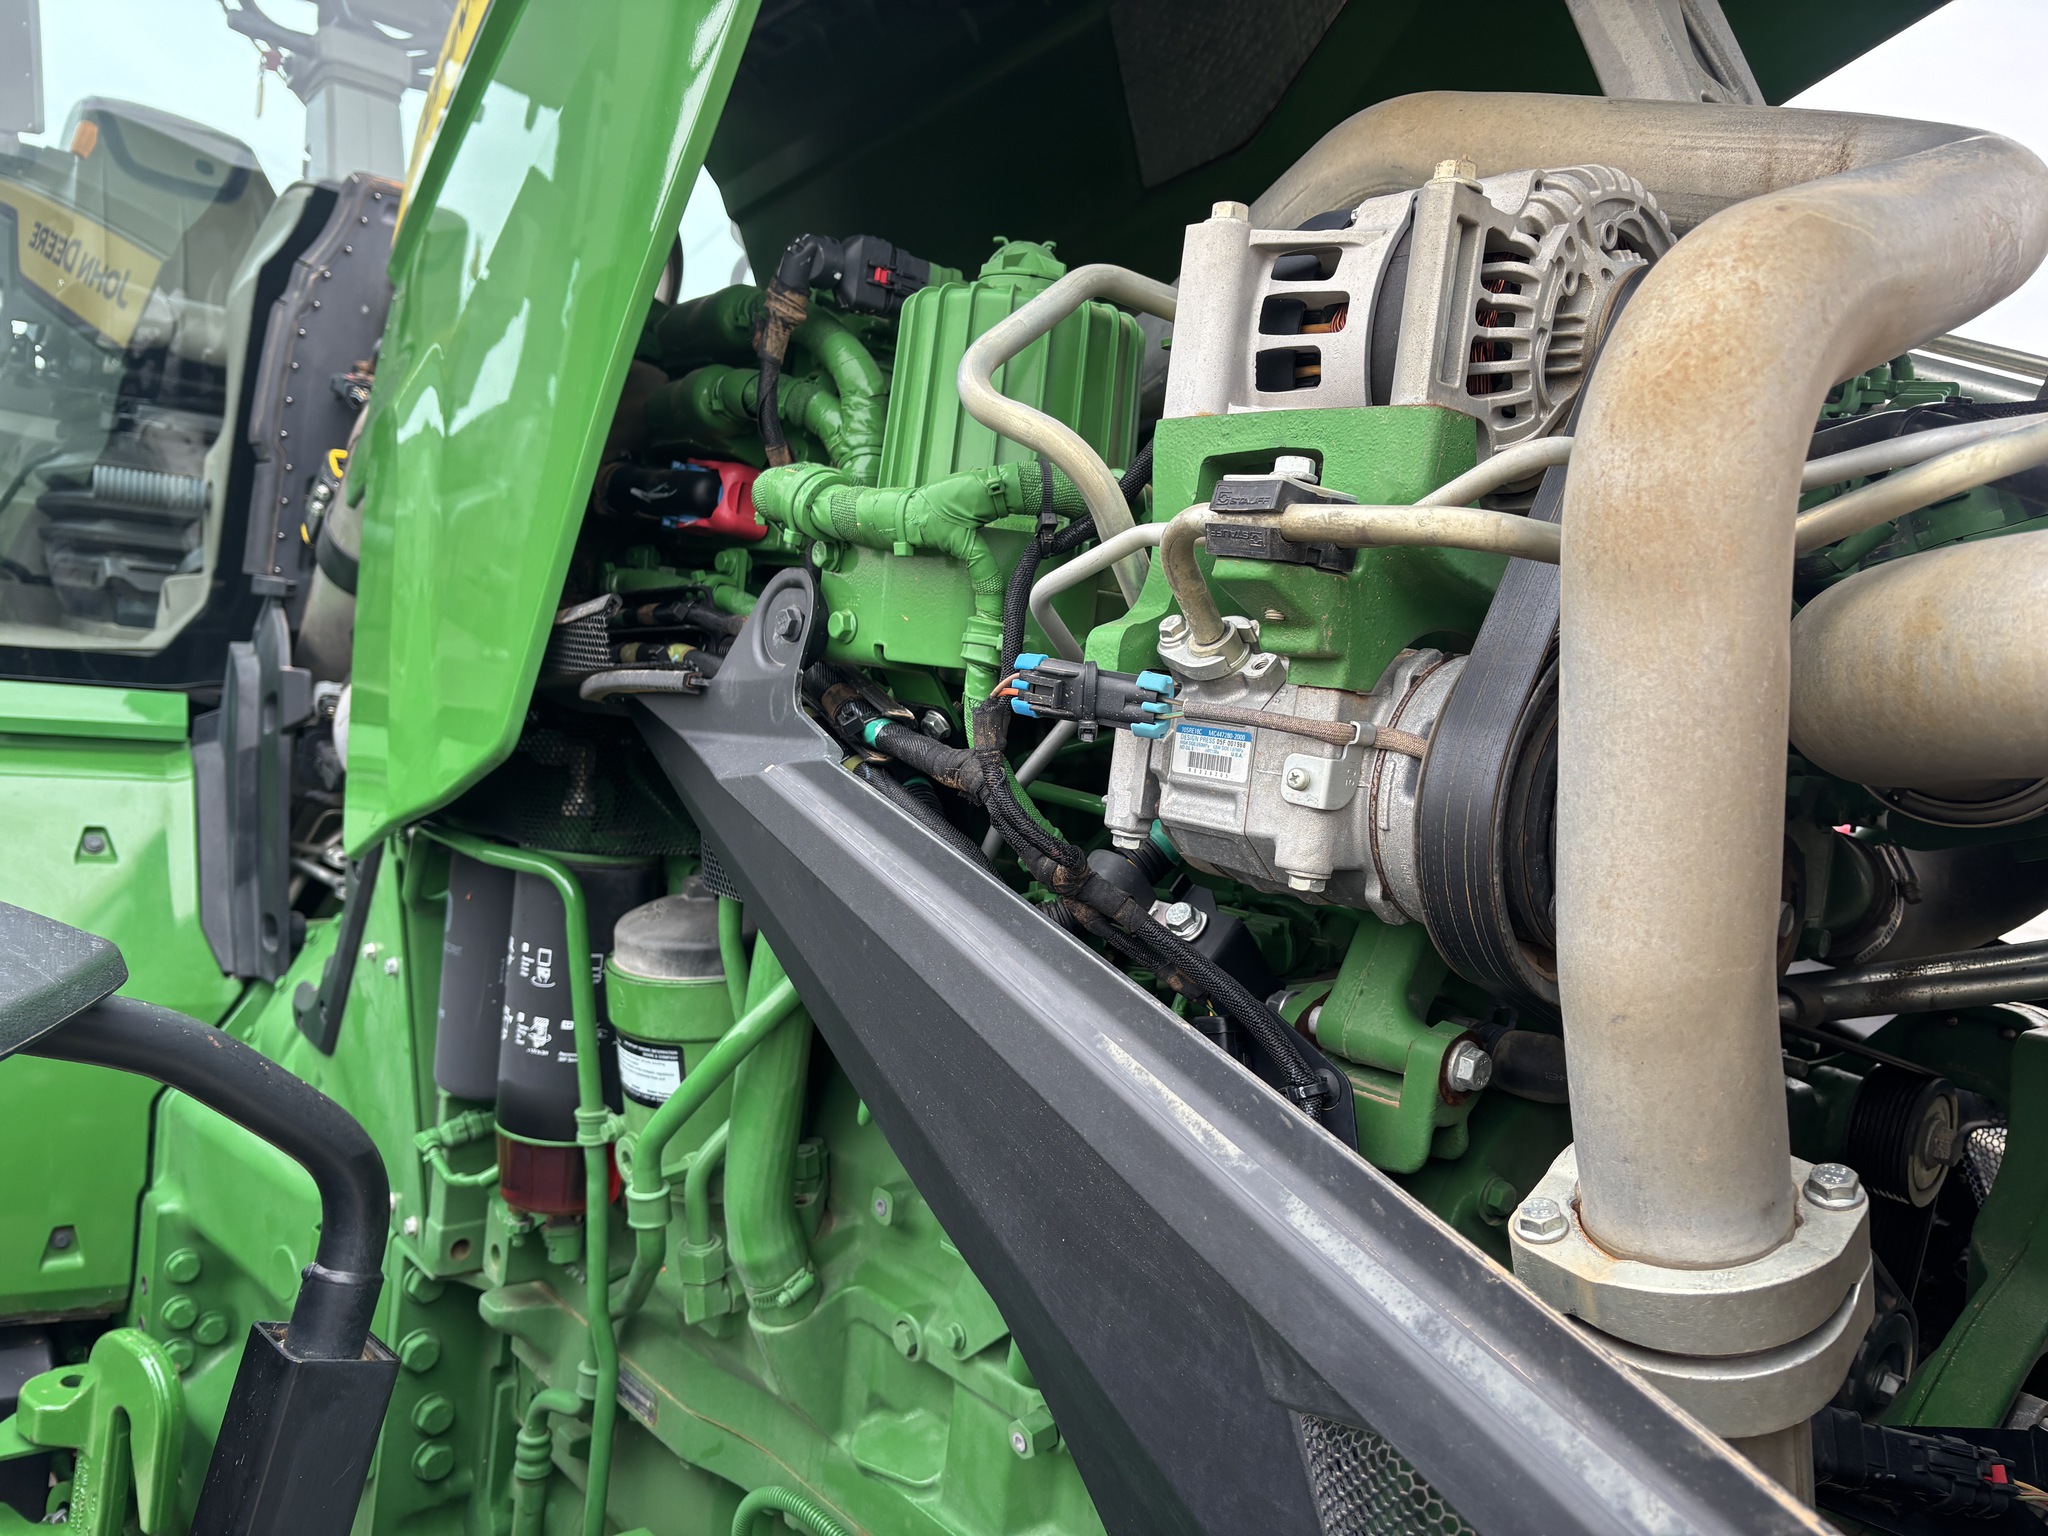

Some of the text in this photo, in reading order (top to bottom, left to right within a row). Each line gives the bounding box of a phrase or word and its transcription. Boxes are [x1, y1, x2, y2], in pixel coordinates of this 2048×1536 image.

[1229, 496, 1271, 505] STAUFF
[1210, 530, 1250, 539] STAUFF
[1199, 736, 1216, 745] PRESS
